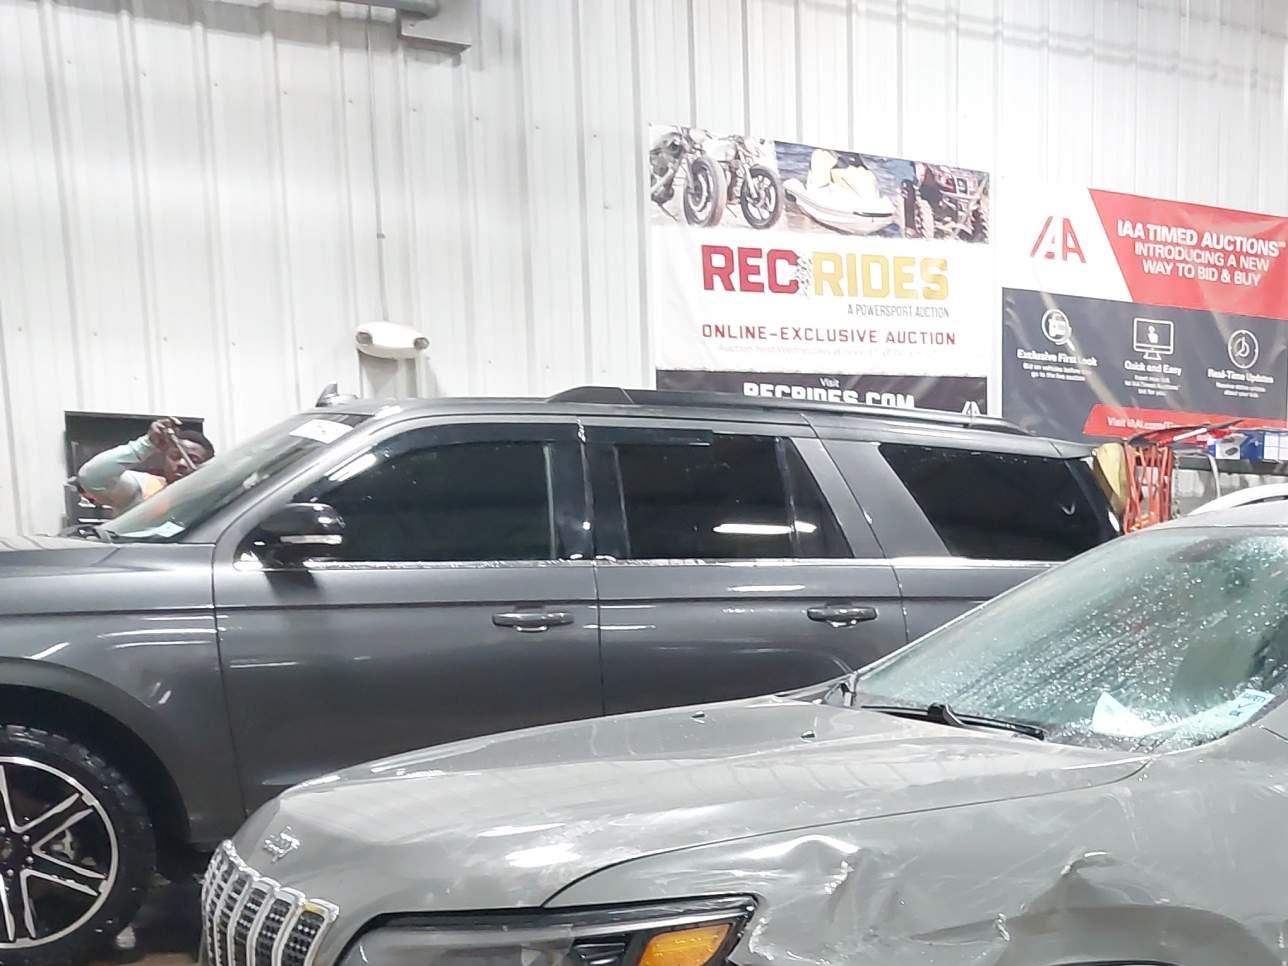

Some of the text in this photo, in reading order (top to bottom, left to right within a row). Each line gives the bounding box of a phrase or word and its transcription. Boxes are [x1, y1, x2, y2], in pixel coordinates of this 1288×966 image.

[1117, 219, 1145, 241] IAA
[1146, 223, 1198, 245] TIMED
[1135, 241, 1269, 272] INTRODUCING A NEW
[812, 251, 949, 300] RIDES
[1142, 259, 1261, 287] WAY TO BID & BUY
[915, 306, 950, 318] AUCTION
[702, 324, 956, 345] ONLINE-EXCLUSIVE AUCTION
[1124, 360, 1146, 371] Quick
[1163, 364, 1182, 376] Easy
